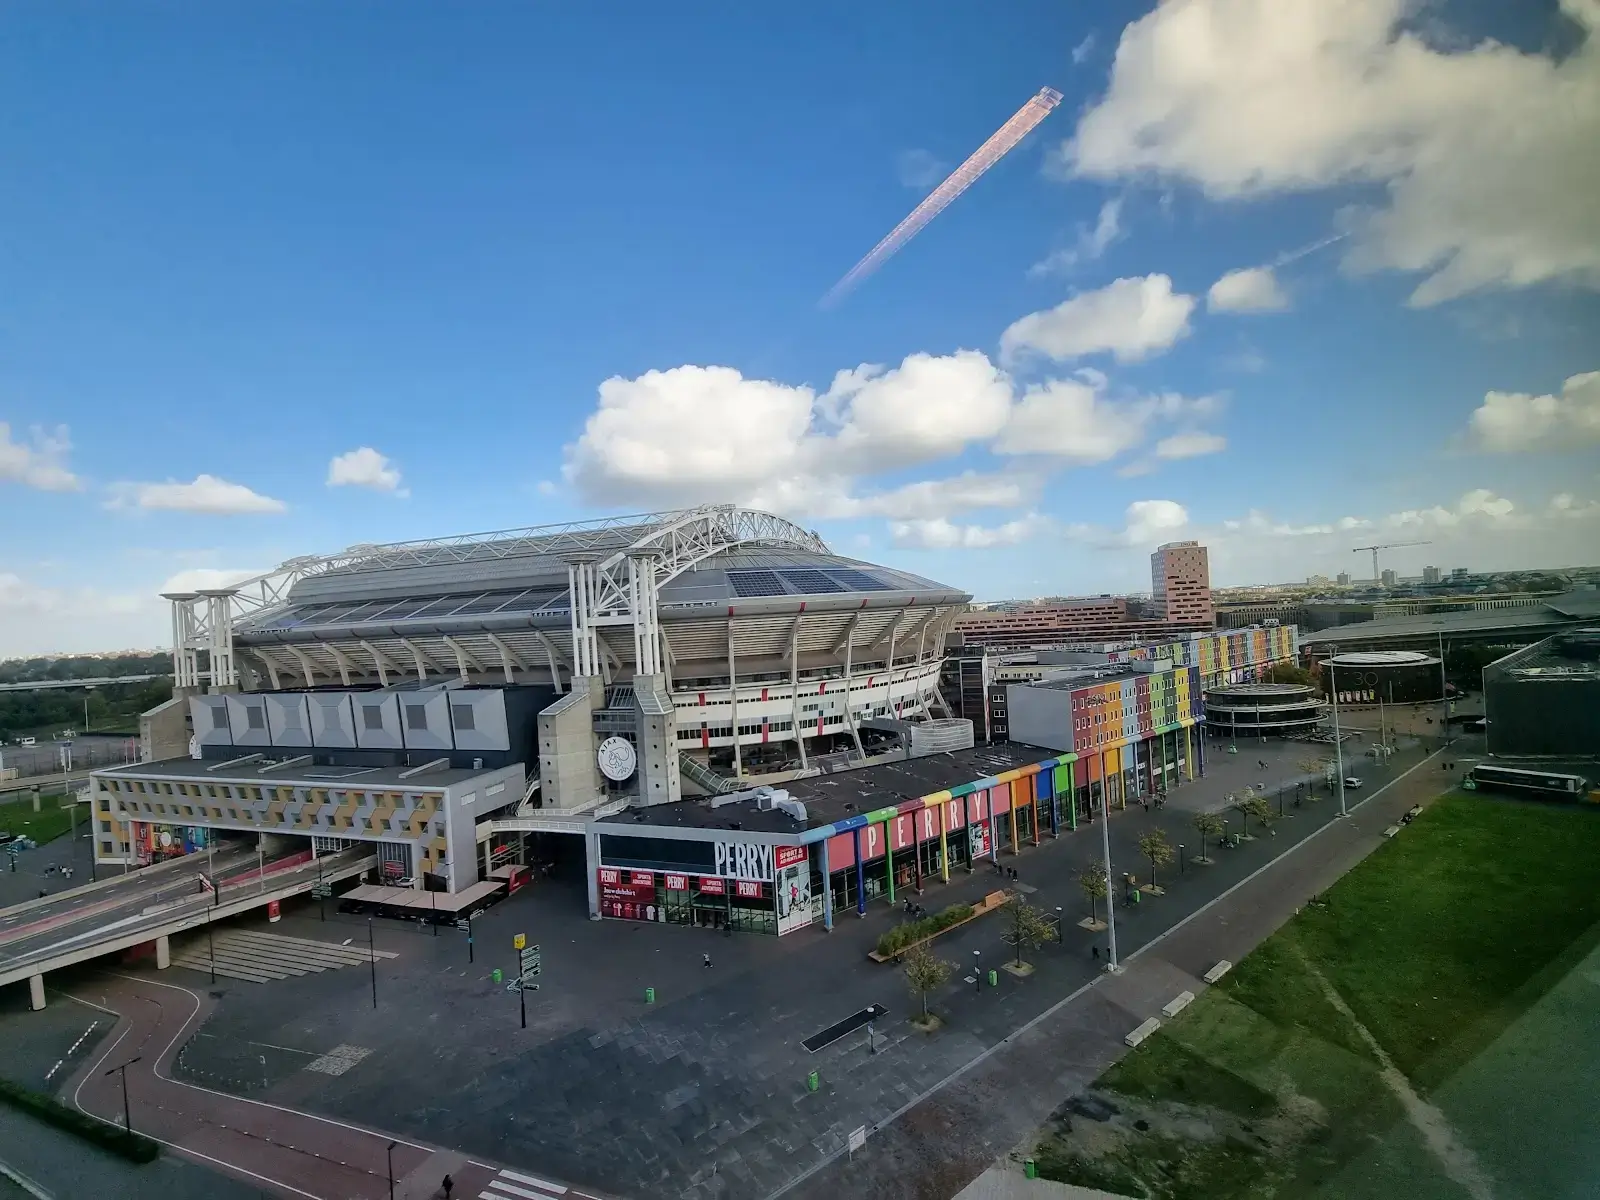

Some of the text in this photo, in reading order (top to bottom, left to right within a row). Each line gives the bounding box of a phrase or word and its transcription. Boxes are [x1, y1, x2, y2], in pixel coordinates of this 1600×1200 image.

[600, 738, 617, 755] AJAX
[867, 791, 982, 858] PERRY
[779, 848, 798, 860] SPORT
[600, 869, 618, 884] PERRY
[666, 875, 685, 890] PERRY
[738, 881, 758, 897] PERRY
